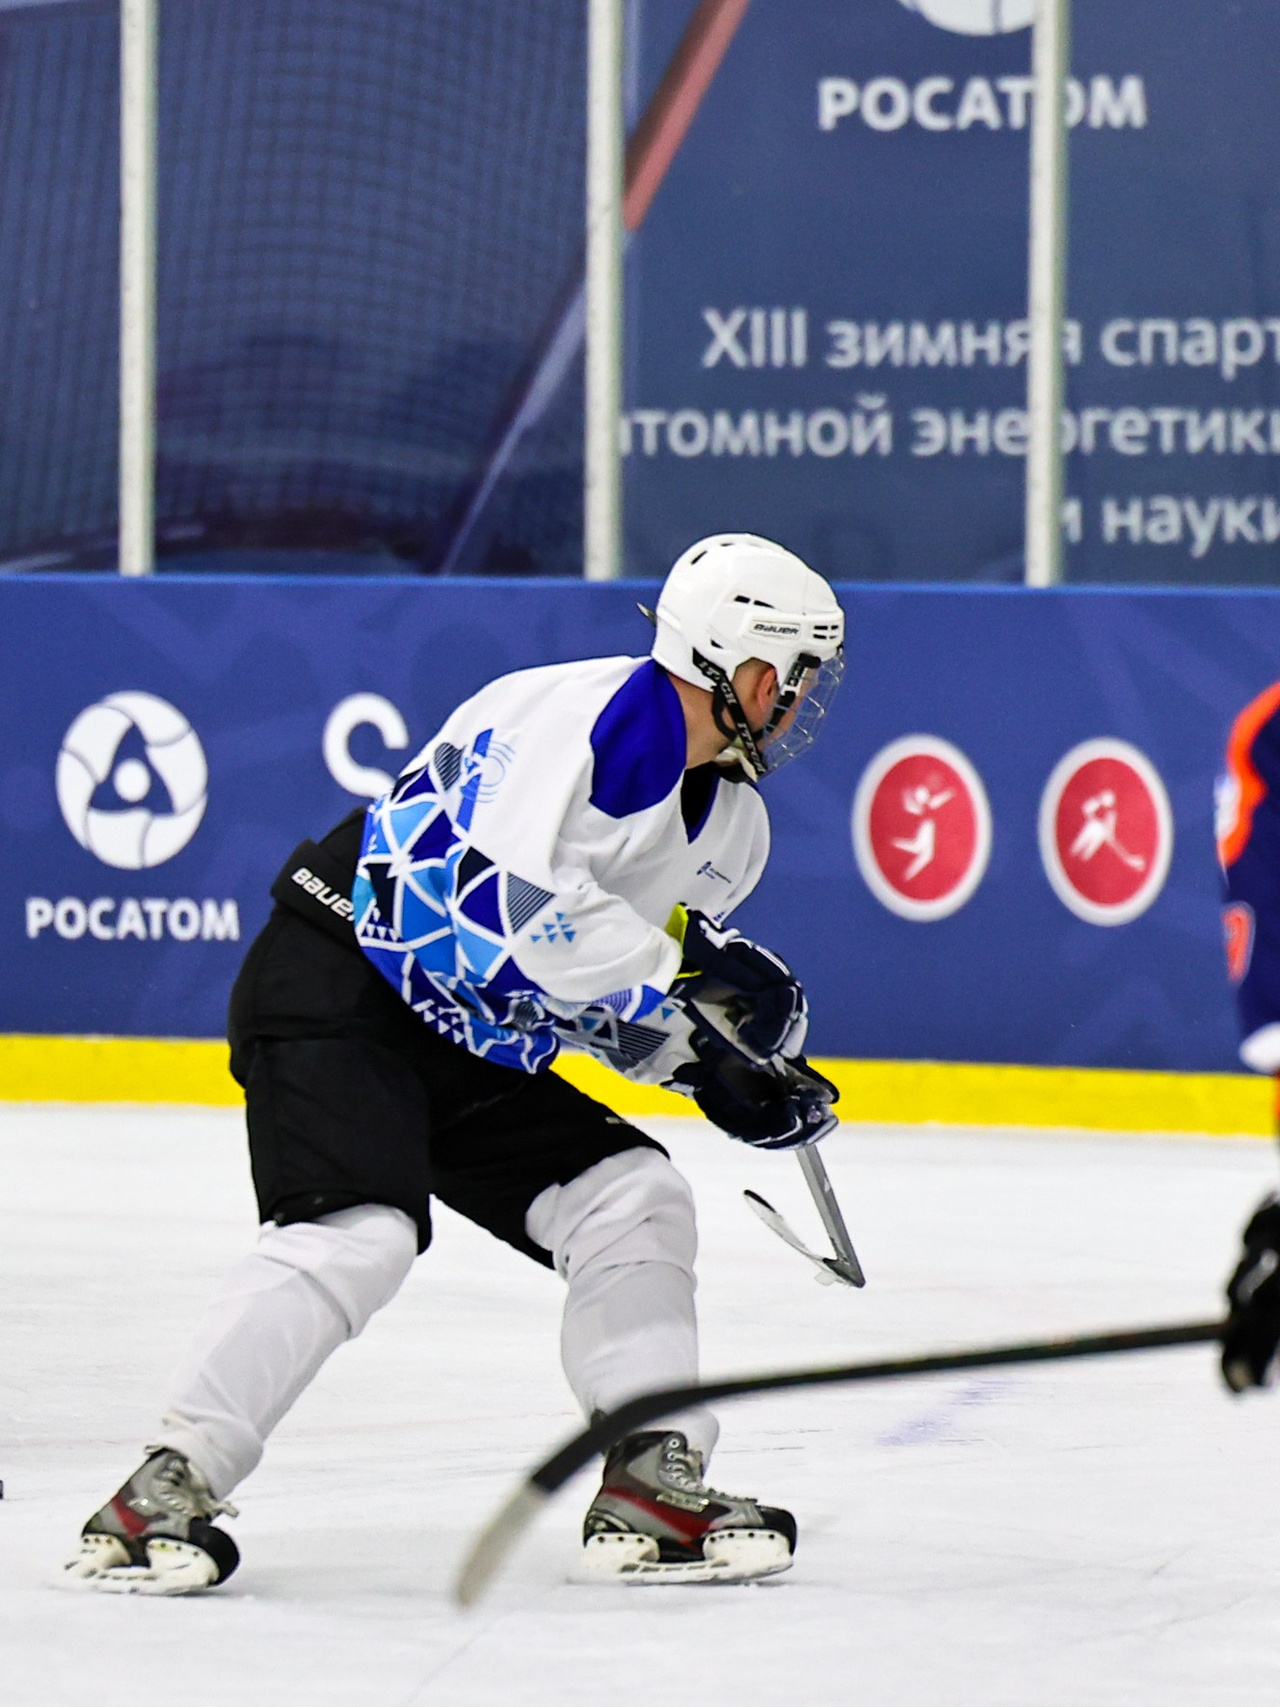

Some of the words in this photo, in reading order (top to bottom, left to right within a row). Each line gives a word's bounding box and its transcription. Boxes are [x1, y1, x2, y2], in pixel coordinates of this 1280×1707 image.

[910, 406, 1280, 457] энегетик
[25, 896, 241, 942] РОСАТОМ
[291, 867, 355, 922] BAUE
